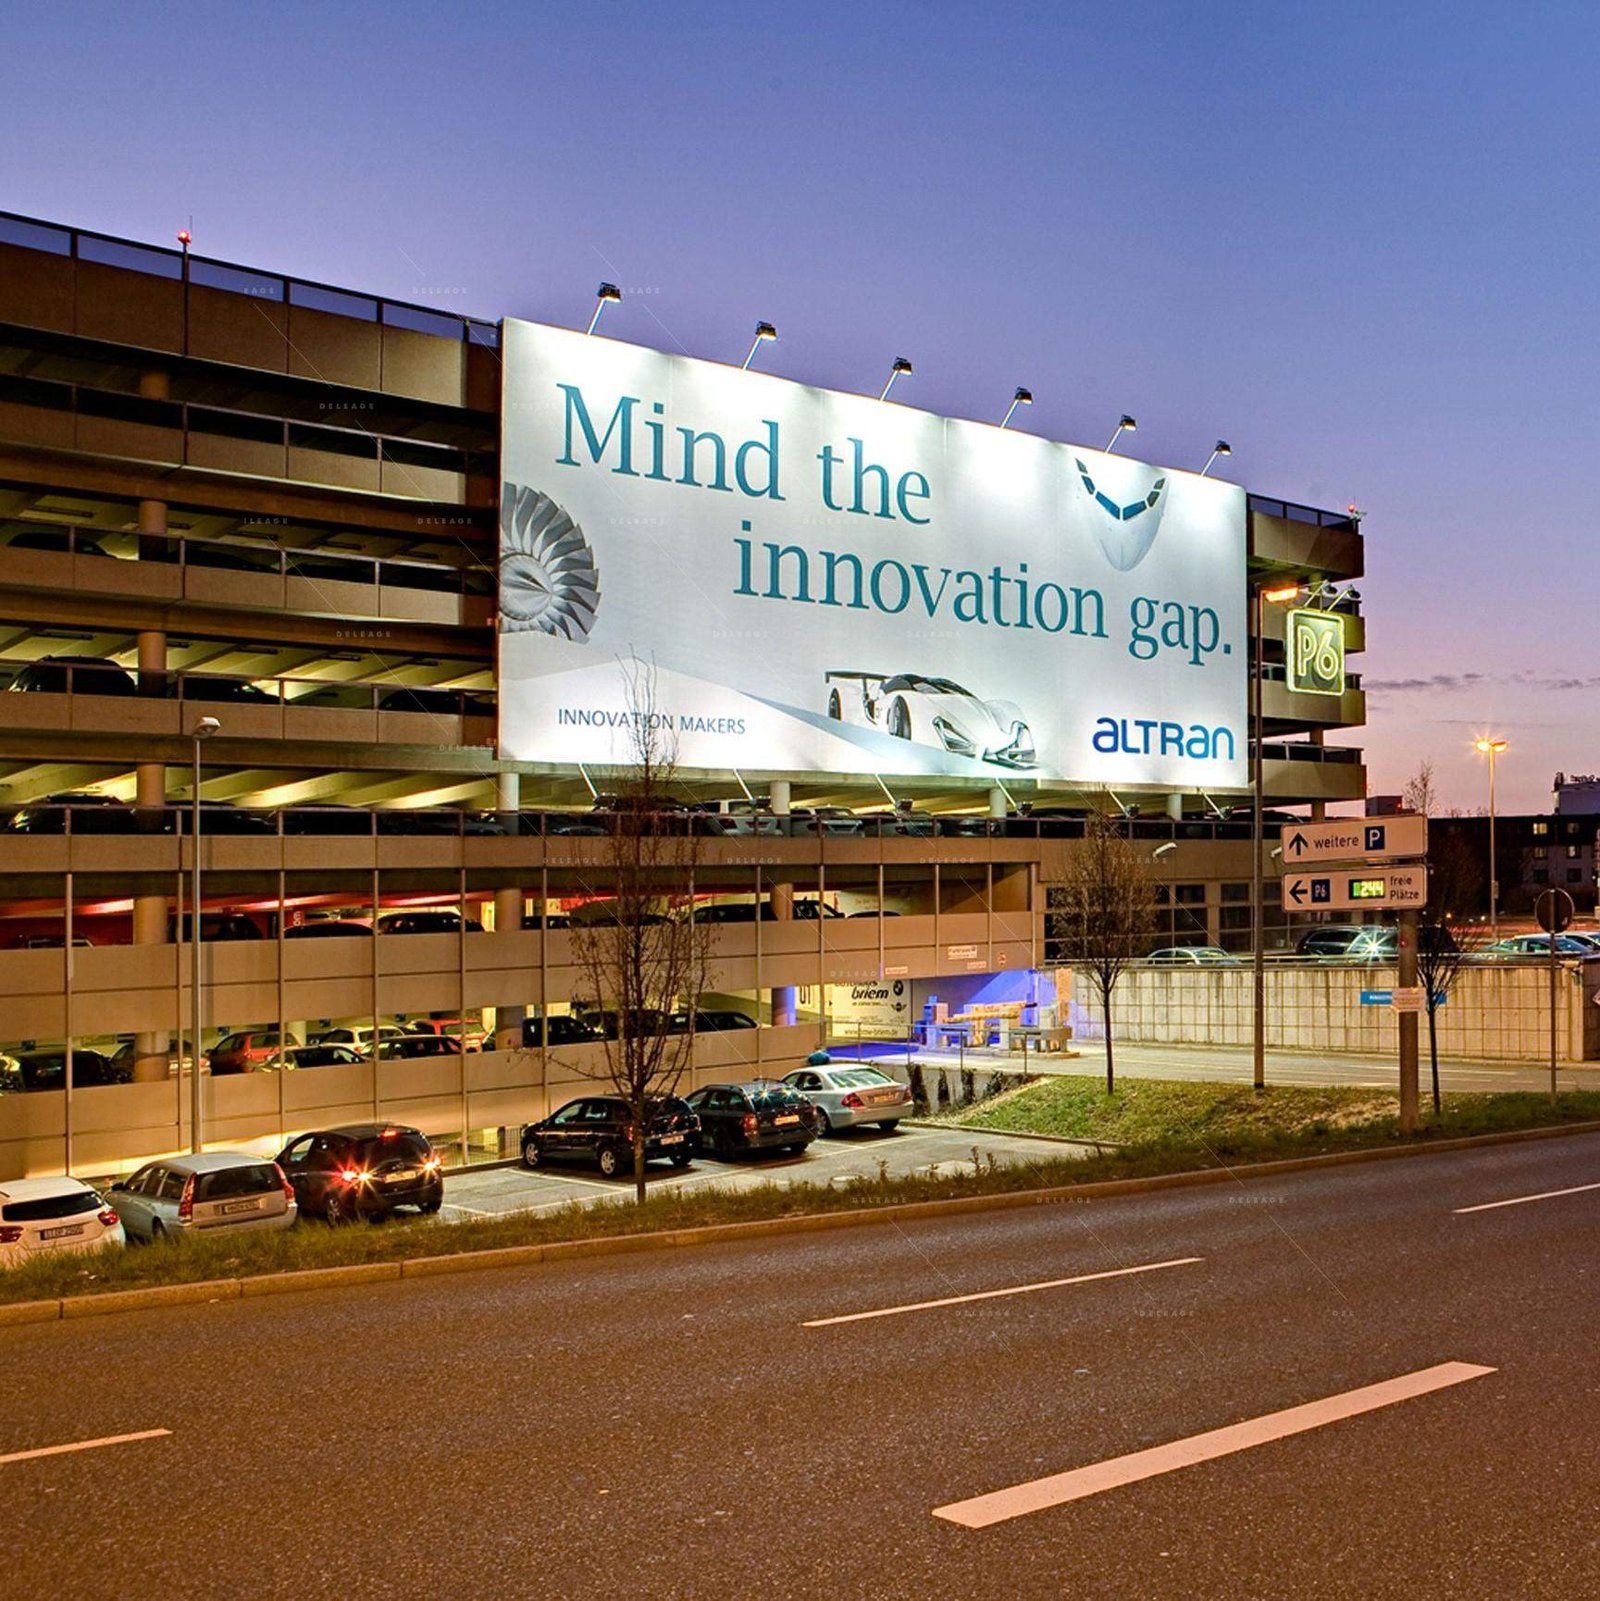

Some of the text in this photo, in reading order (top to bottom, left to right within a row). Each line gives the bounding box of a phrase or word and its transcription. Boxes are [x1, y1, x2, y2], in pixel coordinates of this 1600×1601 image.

[555, 383, 932, 523] Mind the
[734, 519, 1232, 666] innovation gap.
[1298, 624, 1339, 680] P6
[557, 707, 746, 735] INNOVATION MAKERS
[1313, 828, 1381, 849] weitere P
[1389, 875, 1413, 886] freie
[1389, 888, 1420, 900] Plätze
[851, 985, 889, 1000] briem
